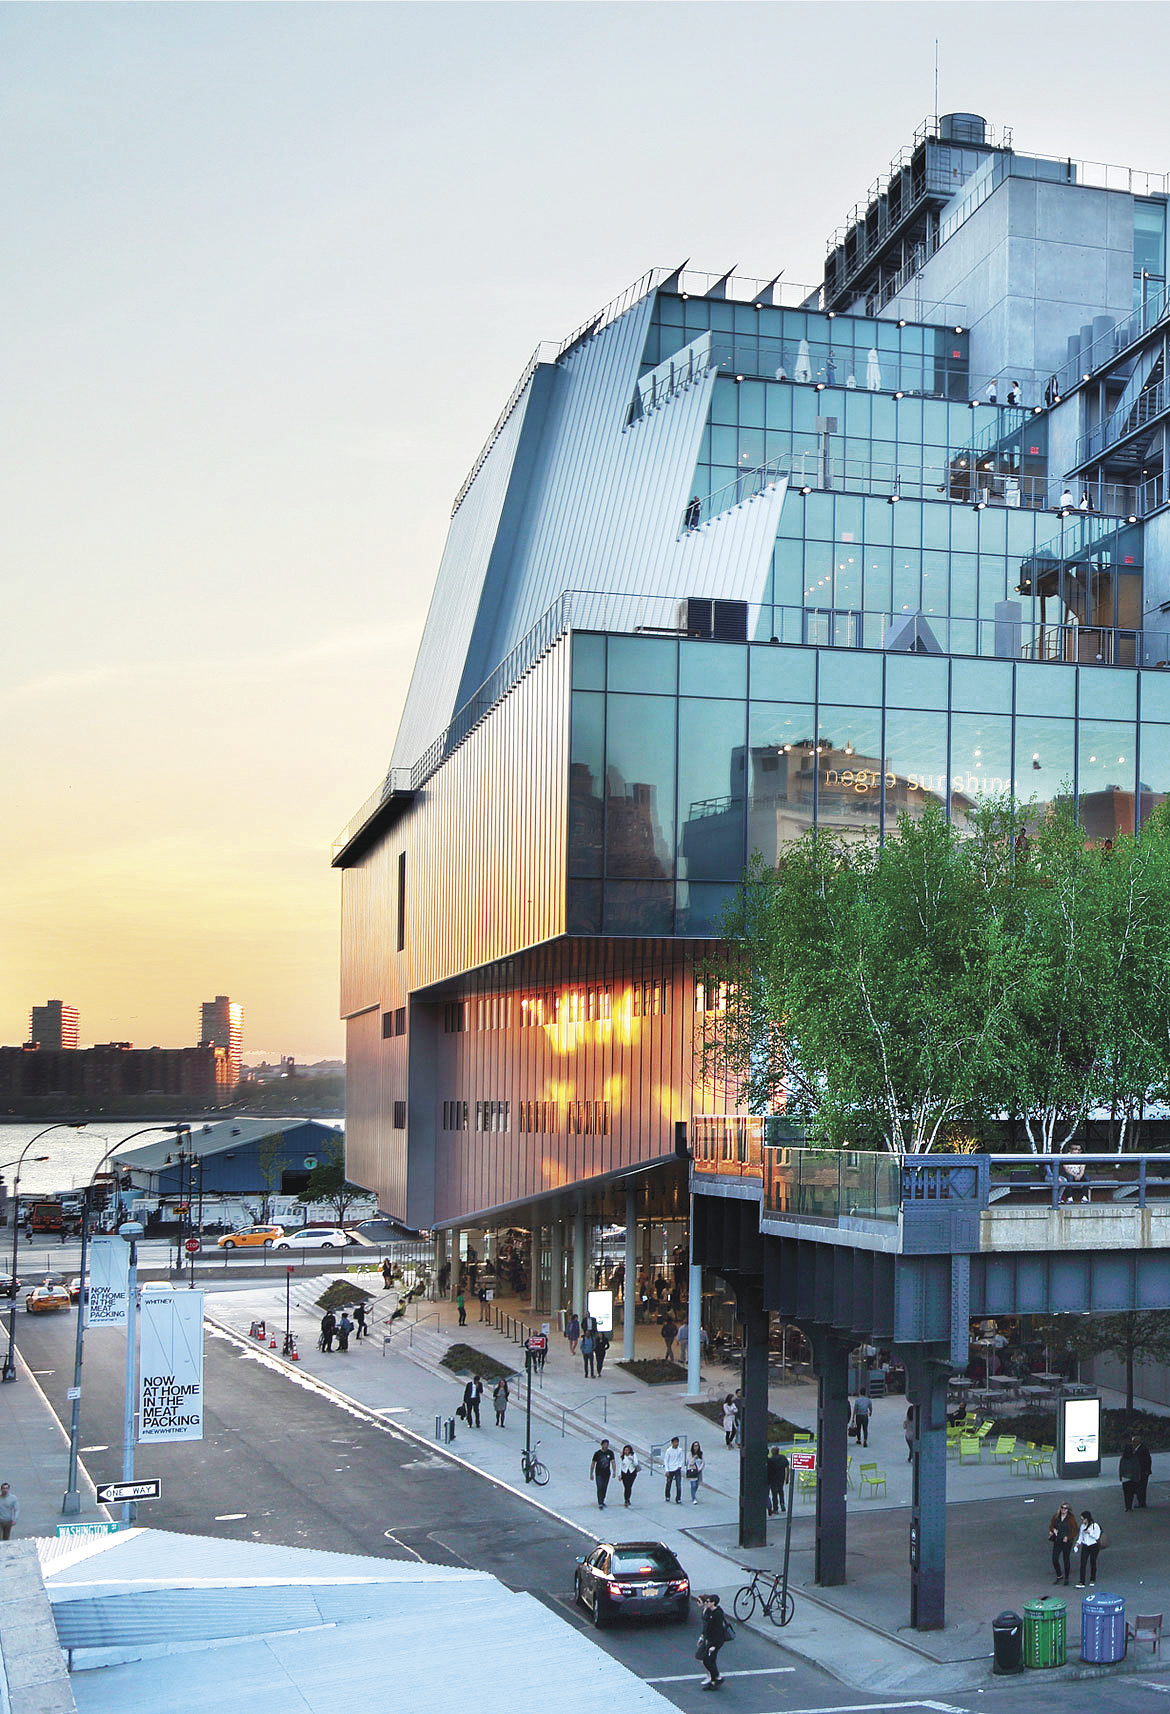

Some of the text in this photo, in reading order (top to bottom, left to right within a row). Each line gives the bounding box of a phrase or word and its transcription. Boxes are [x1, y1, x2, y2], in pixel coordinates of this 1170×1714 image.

[825, 768, 897, 793] negro
[91, 1286, 111, 1294] NOW
[90, 1311, 126, 1319] PACKING
[143, 1375, 176, 1388] NOW
[143, 1384, 200, 1398] AT HOME
[143, 1395, 185, 1407] IN THE
[143, 1406, 179, 1418] MEAT
[143, 1414, 201, 1428] PACKING
[142, 1426, 188, 1435] #NEWWHITNEY
[106, 1485, 152, 1498] ONE WAY
[58, 1524, 109, 1537] WASHINGTON
